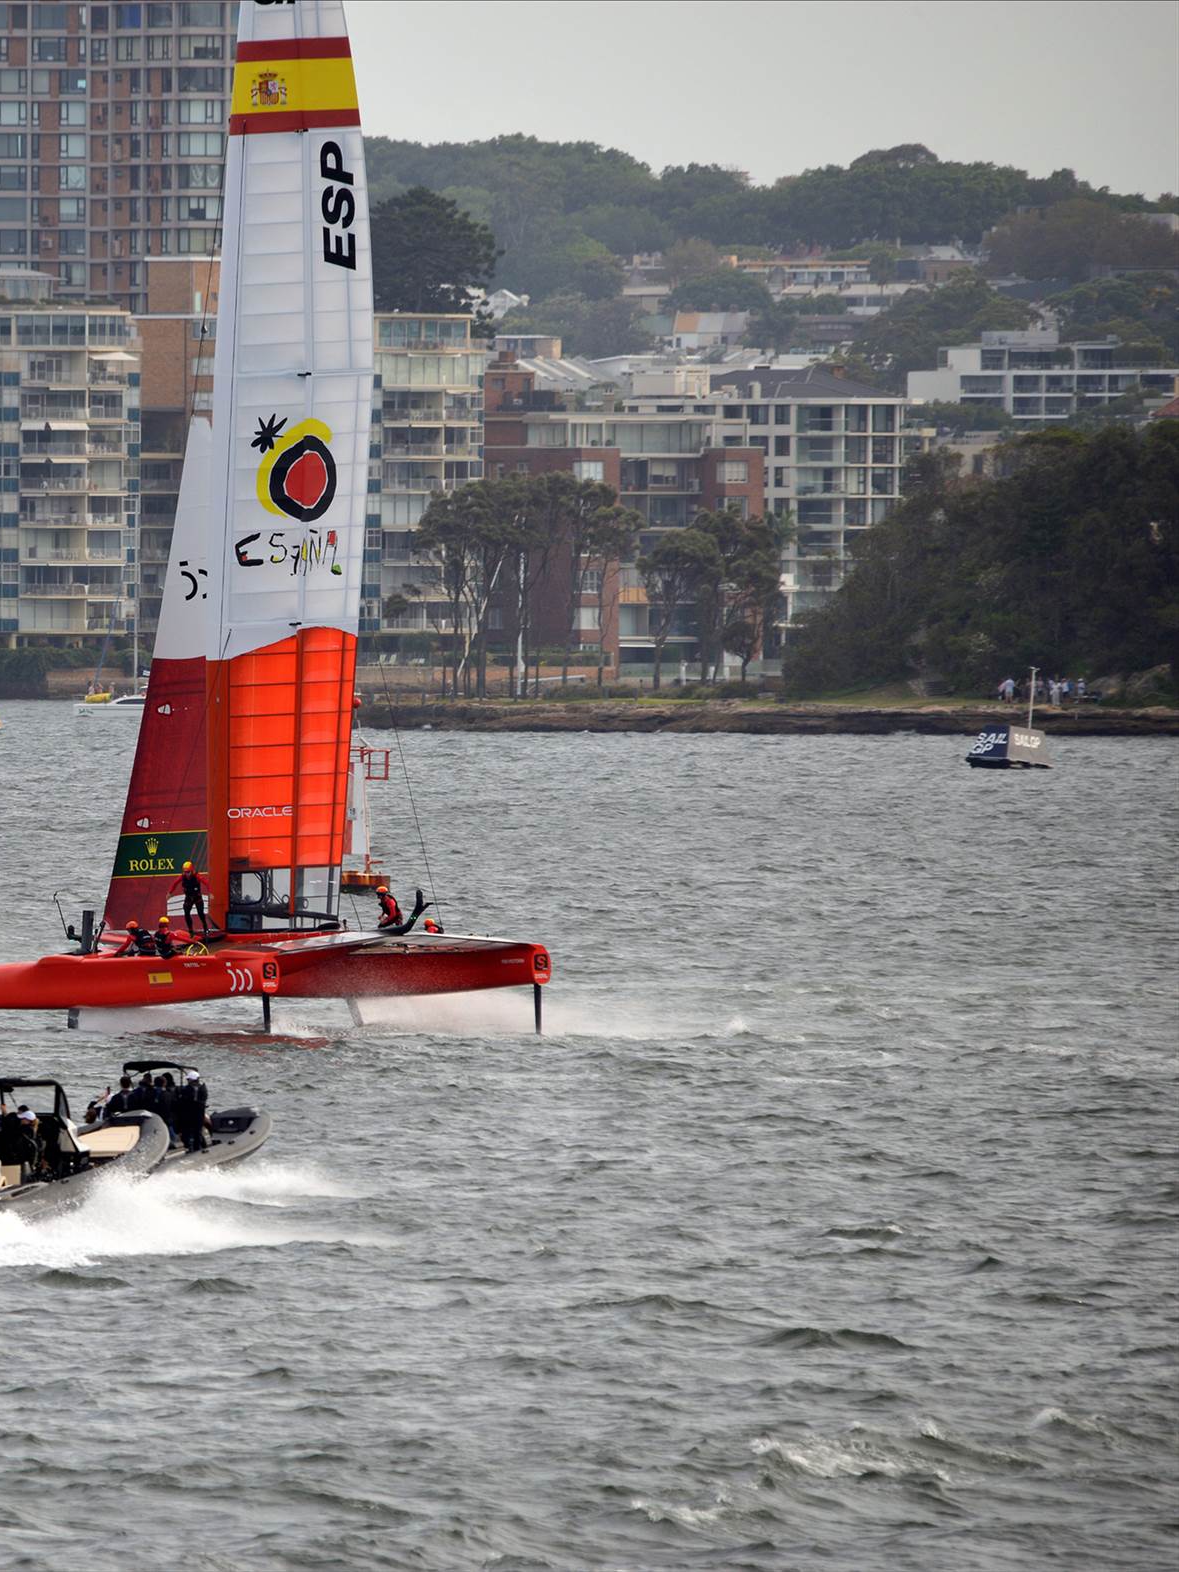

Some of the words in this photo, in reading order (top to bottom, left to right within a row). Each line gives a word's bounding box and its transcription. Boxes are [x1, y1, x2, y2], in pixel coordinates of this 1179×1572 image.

[320, 140, 357, 270] ESP
[976, 733, 1007, 744] SAIL
[971, 743, 993, 753] GP
[227, 806, 293, 819] ORACLE
[129, 858, 175, 872] ROLEX
